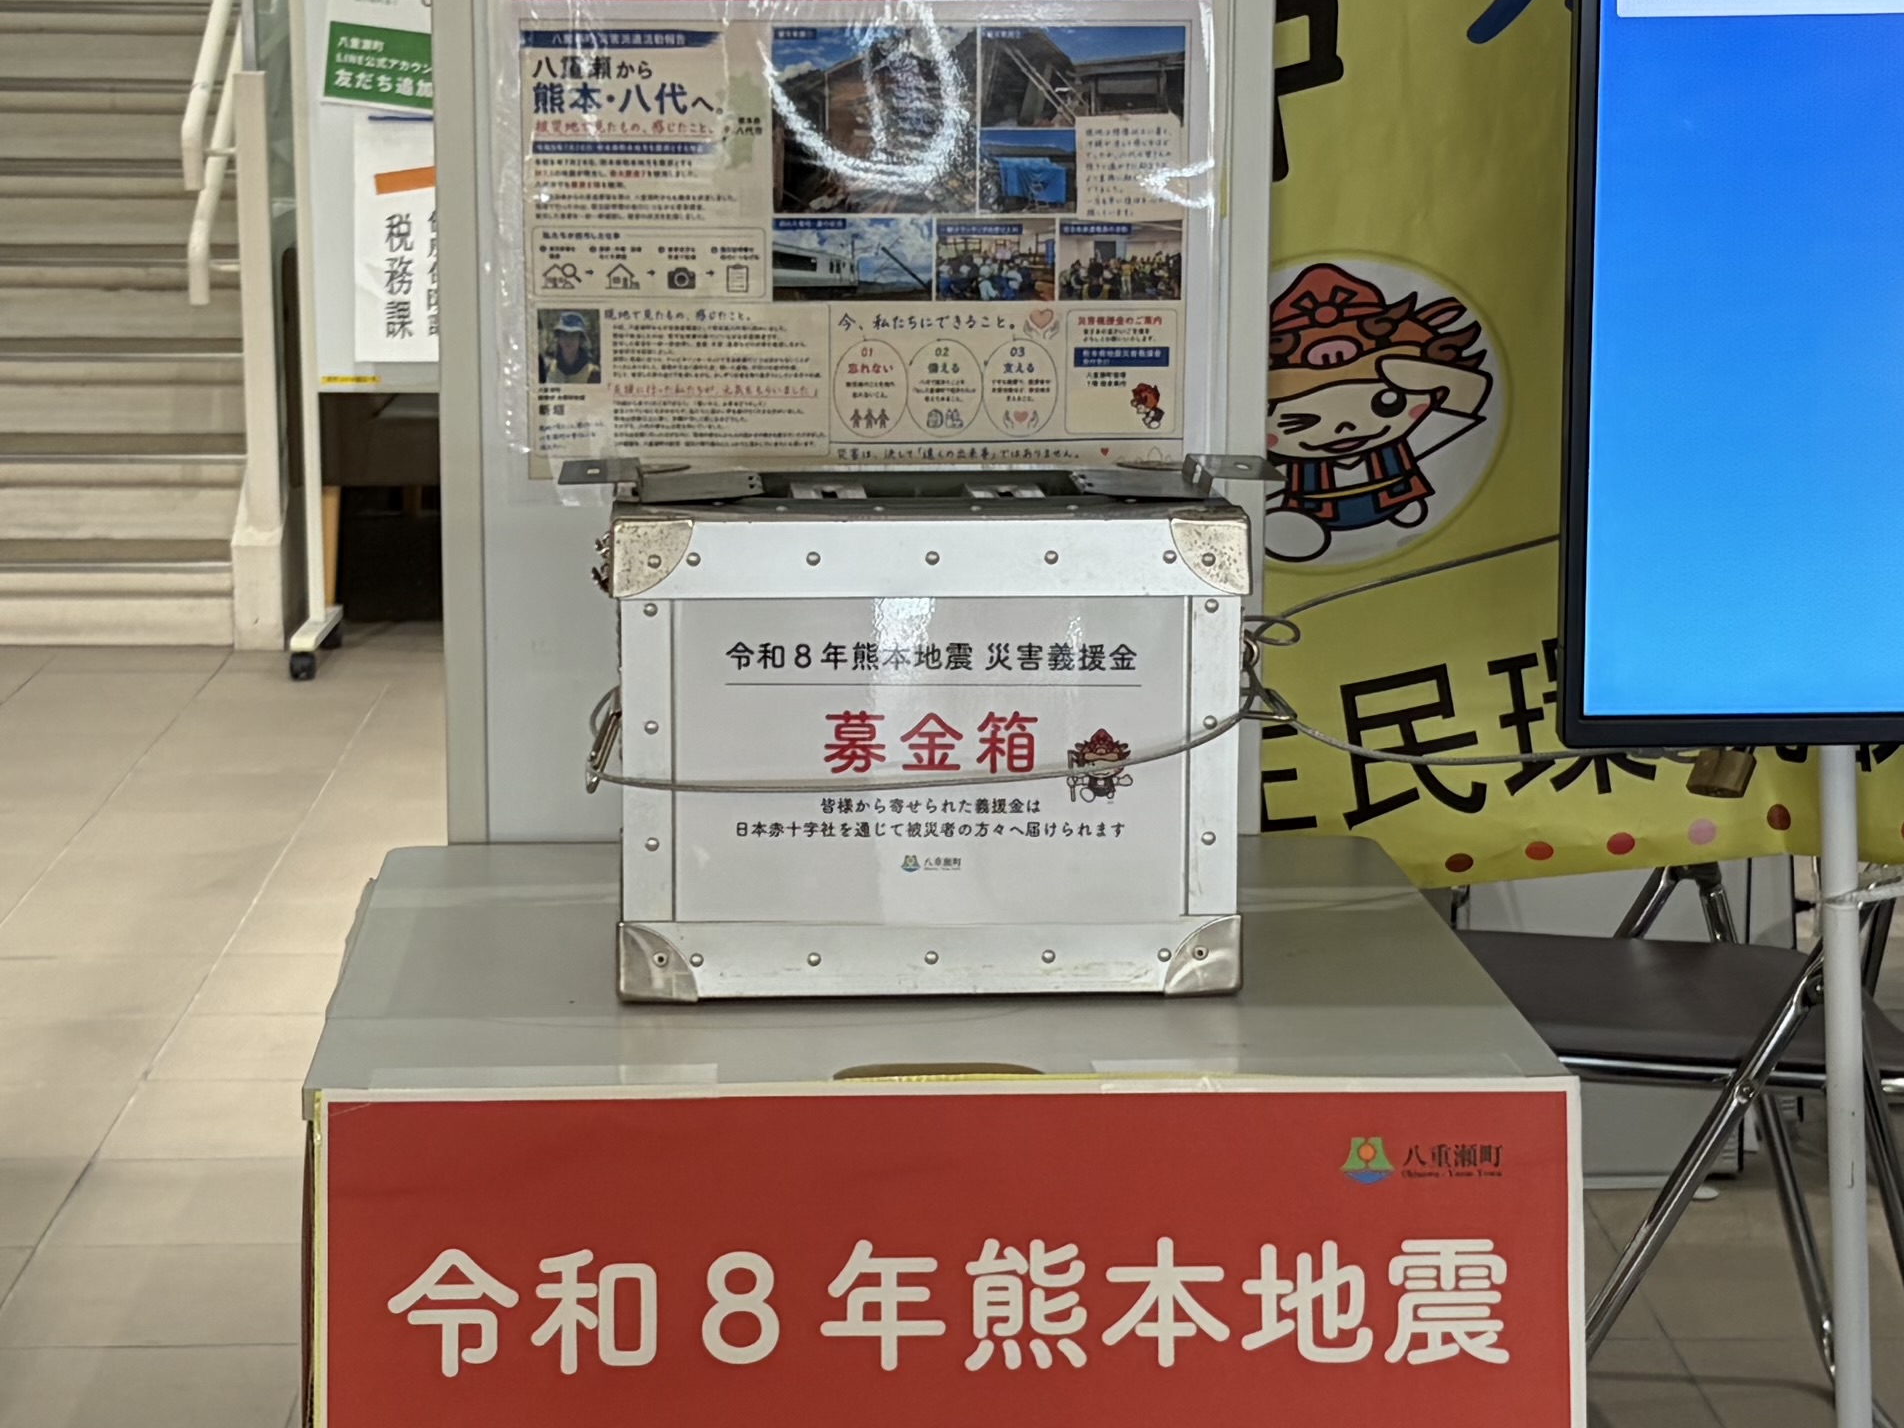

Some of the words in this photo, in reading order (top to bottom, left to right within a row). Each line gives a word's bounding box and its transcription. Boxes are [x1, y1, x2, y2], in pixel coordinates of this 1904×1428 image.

[334, 68, 433, 98] 友だち追加
[533, 81, 723, 115] 熊本・八代へ。
[384, 213, 414, 339] 税務課
[838, 312, 1016, 331] 今、私たちにできること。
[861, 347, 874, 358] 01
[934, 347, 950, 358] 02
[1009, 347, 1026, 358] 03
[988, 641, 1138, 672] 災害義援金
[823, 710, 1040, 775] 募金箱
[821, 796, 1041, 816] 皆様から寄せられた義援金は
[735, 820, 1126, 840] 日本赤十字社を通じて被災者の方々へ届けられます
[1403, 1143, 1504, 1168] 八重瀬町
[386, 1236, 1512, 1379] 令和8年熊本地震
